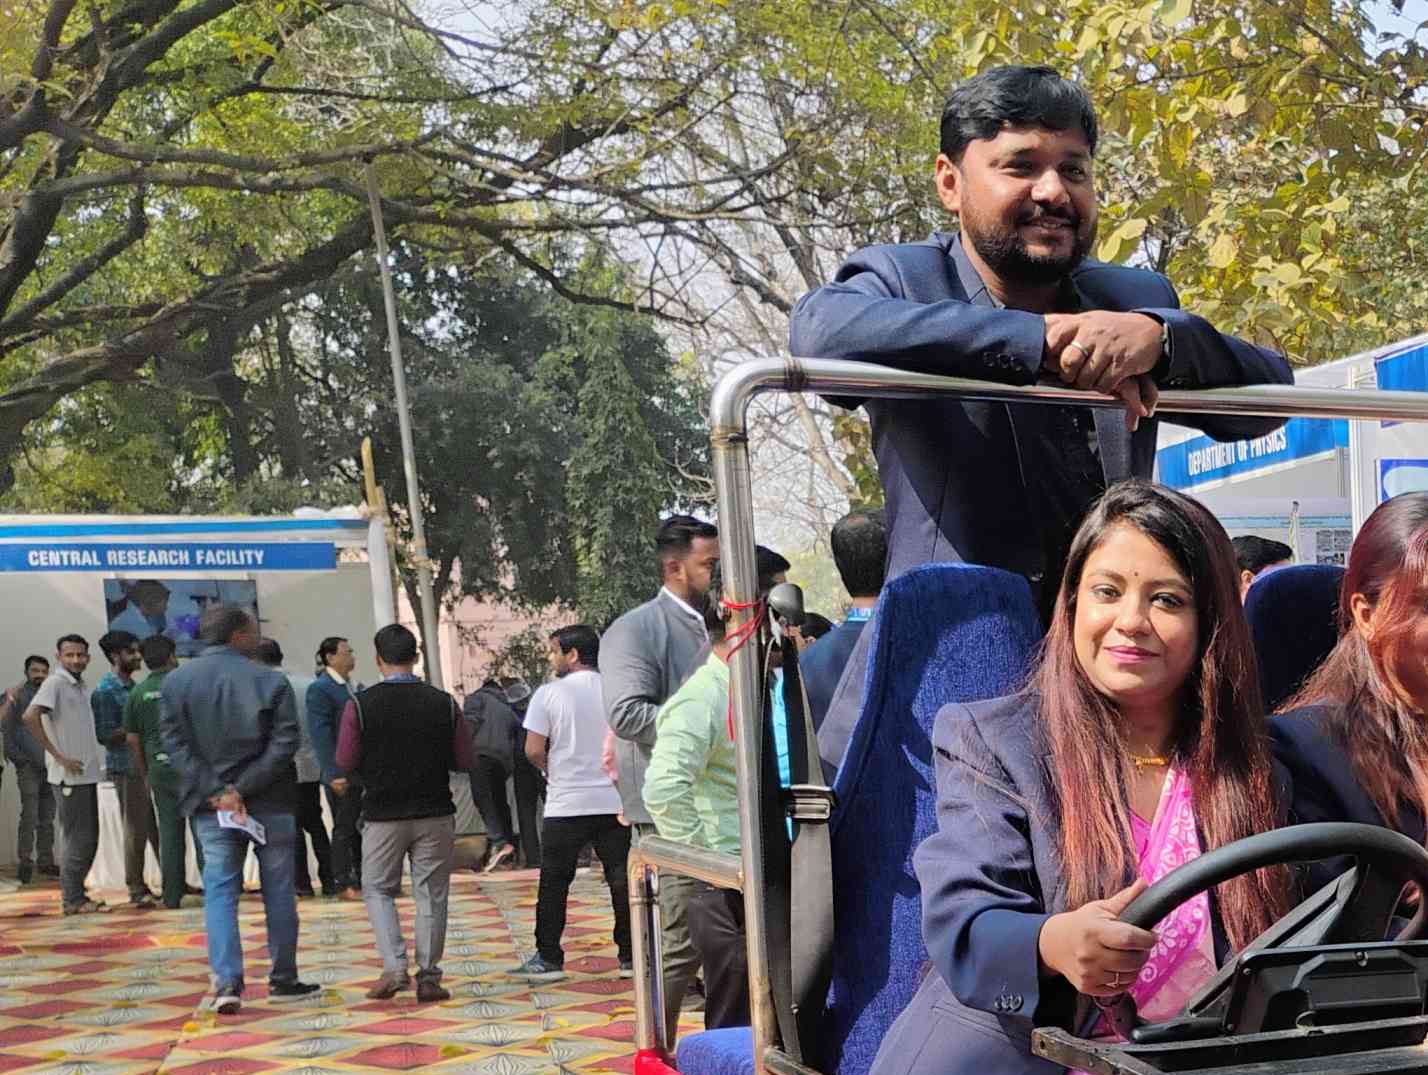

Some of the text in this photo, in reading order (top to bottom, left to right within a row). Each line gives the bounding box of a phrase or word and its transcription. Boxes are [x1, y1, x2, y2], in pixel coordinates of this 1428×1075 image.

[28, 549, 265, 566] CENTRAL RESEARCH FACILITY
